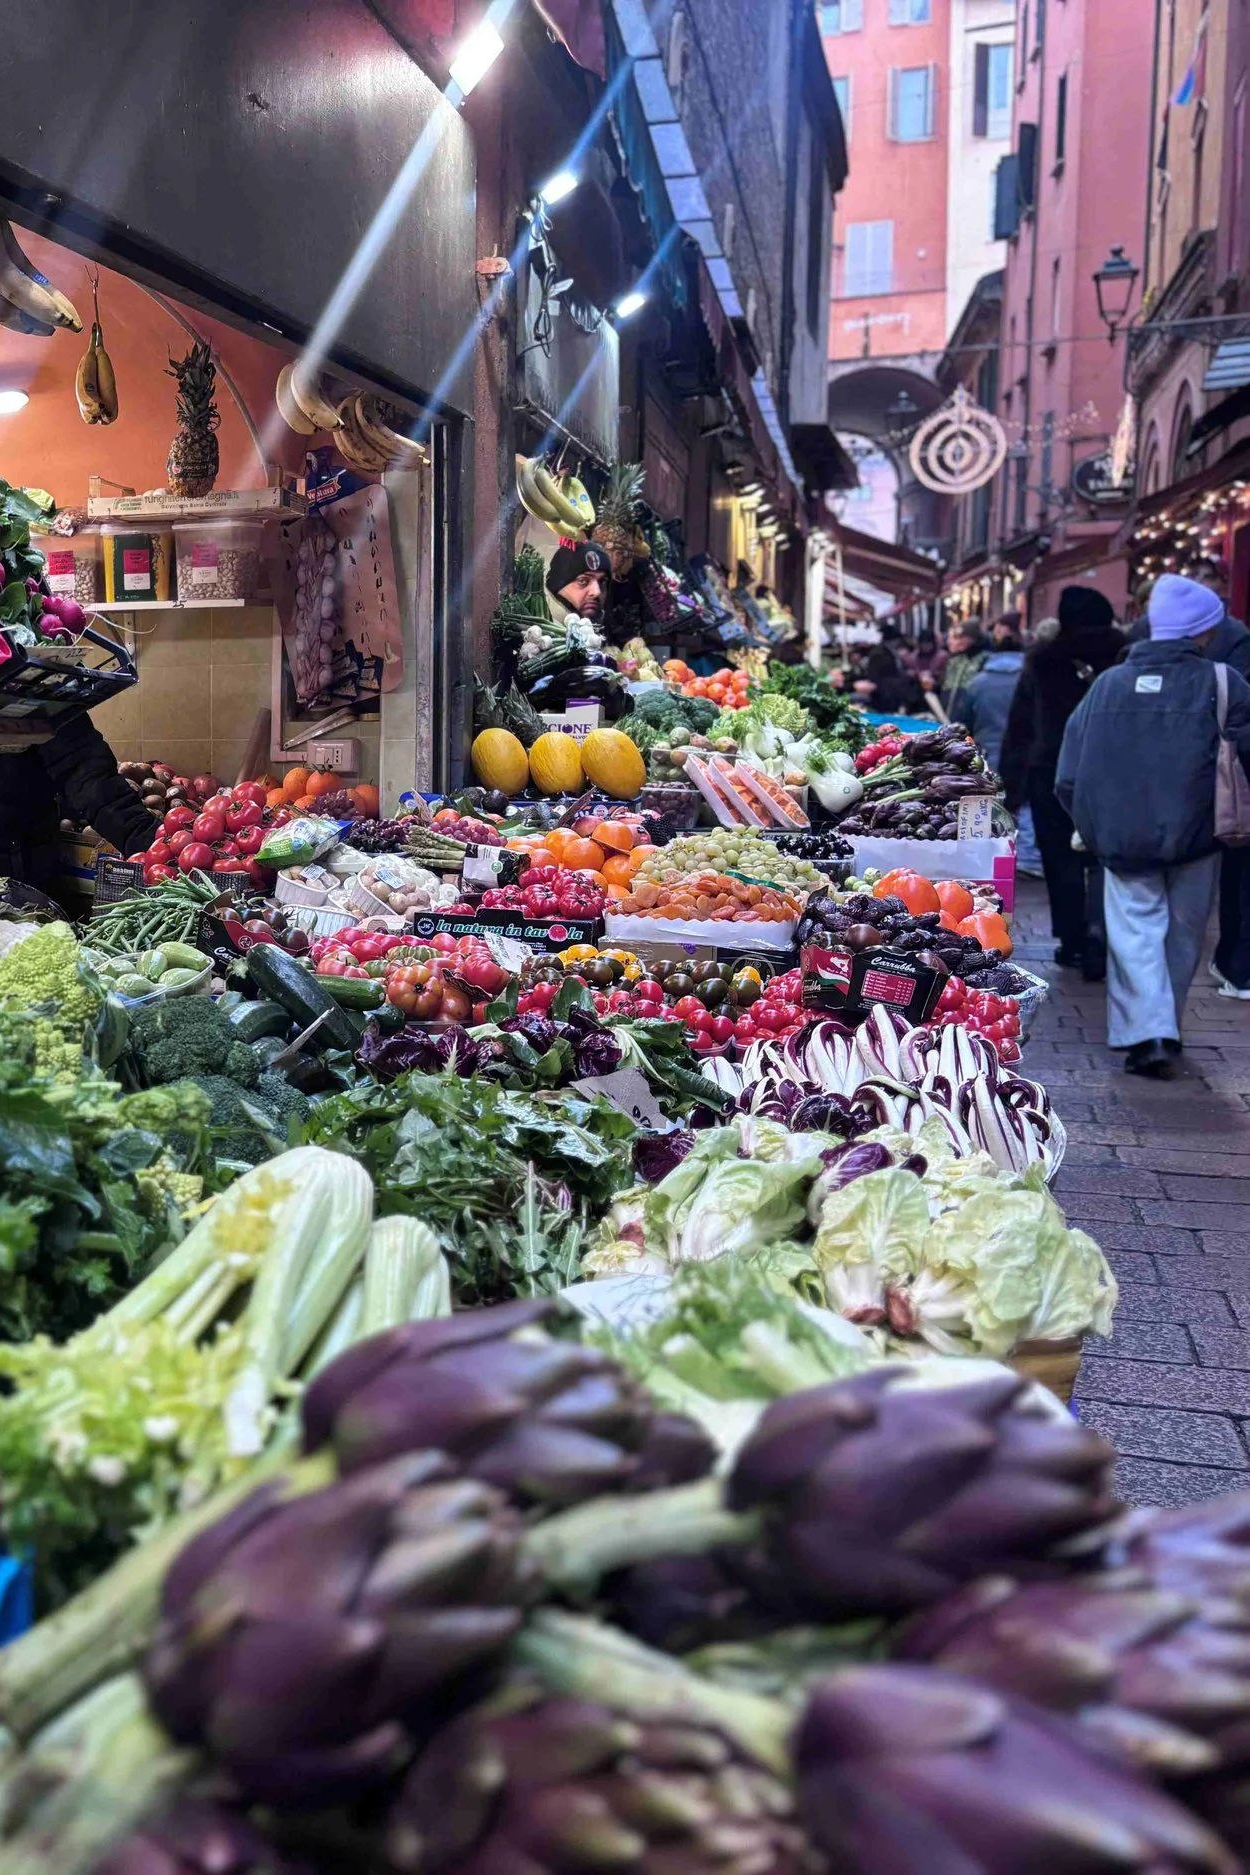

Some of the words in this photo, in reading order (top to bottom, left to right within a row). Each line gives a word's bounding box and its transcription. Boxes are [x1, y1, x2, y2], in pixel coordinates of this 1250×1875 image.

[436, 919, 451, 932] la
[453, 922, 503, 936] natura
[505, 922, 522, 936] in
[870, 956, 916, 973] Carrubba
